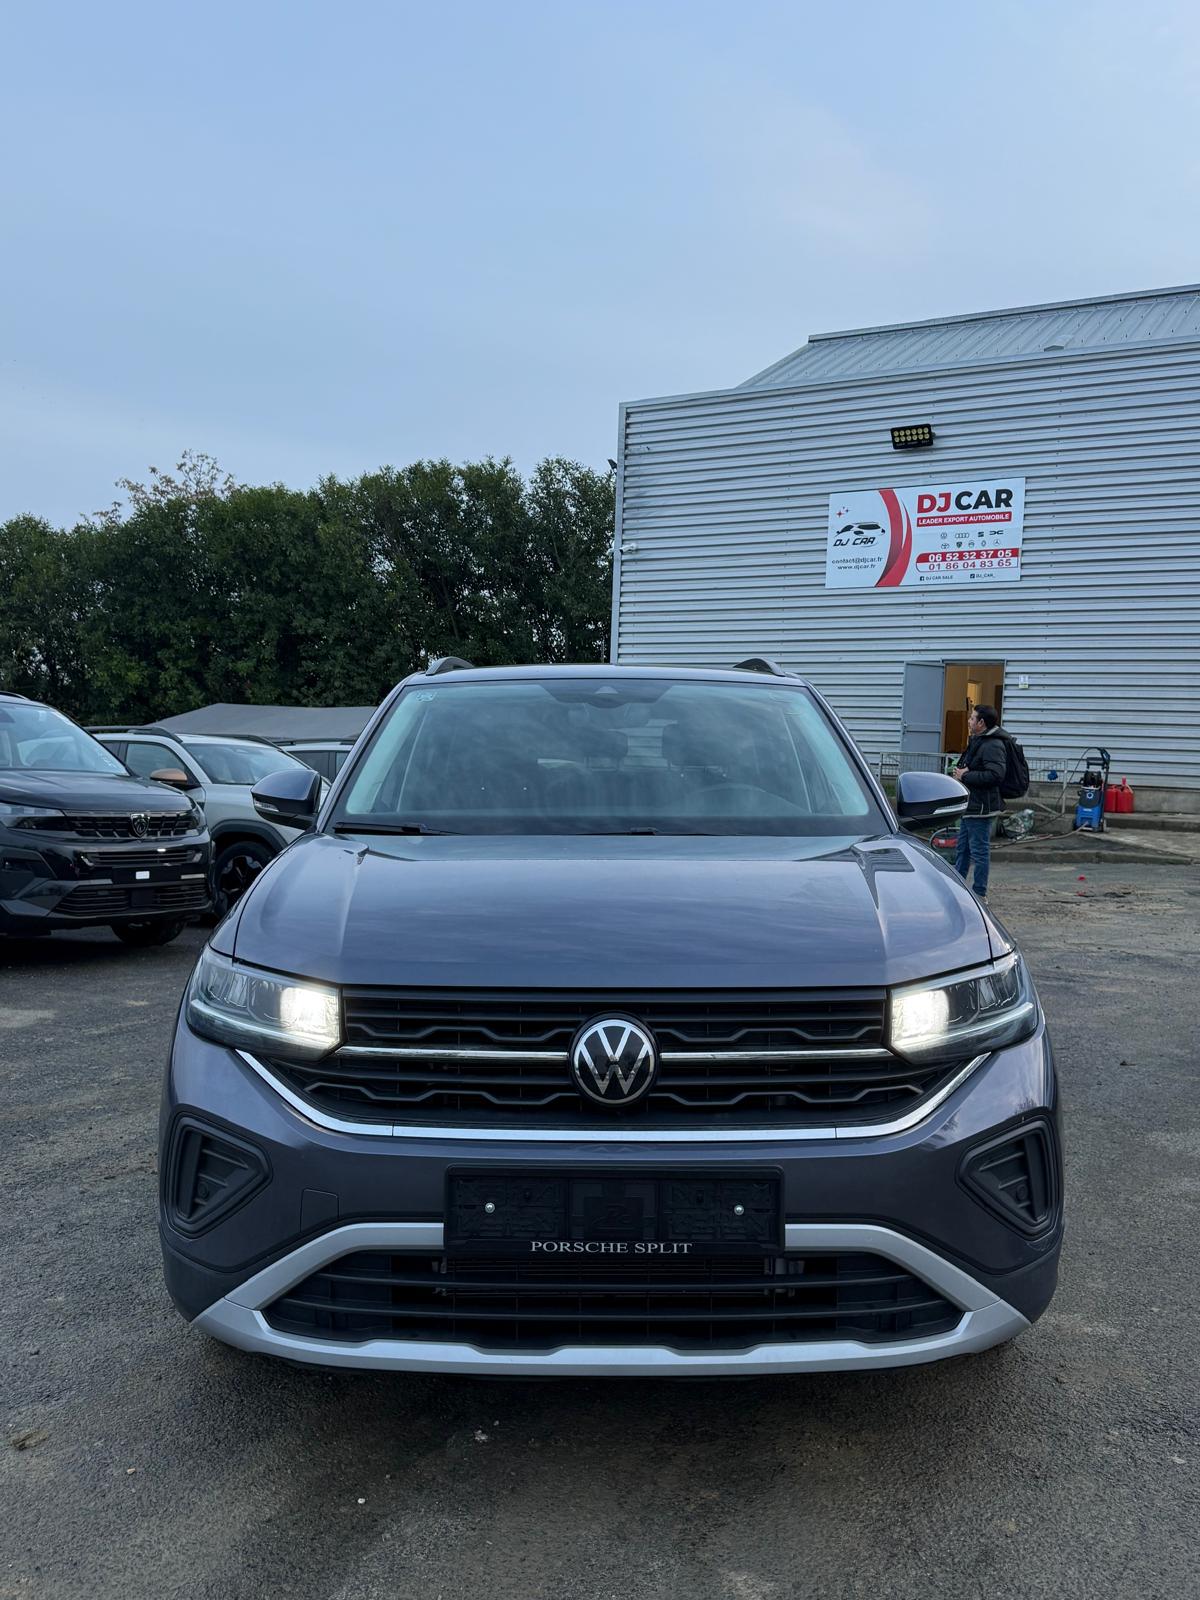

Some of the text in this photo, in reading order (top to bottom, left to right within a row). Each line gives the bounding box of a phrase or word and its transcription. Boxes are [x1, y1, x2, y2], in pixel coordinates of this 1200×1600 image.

[917, 488, 1013, 513] DJ CAR
[918, 517, 943, 525] LEADER
[969, 513, 1010, 522] AUTOMOBILE
[833, 538, 850, 547] DJ
[928, 549, 1012, 562] 06 52 32 37 05
[928, 558, 1012, 571] 01 86 04 83 65
[530, 1241, 693, 1254] PORSCHE SPLIT
